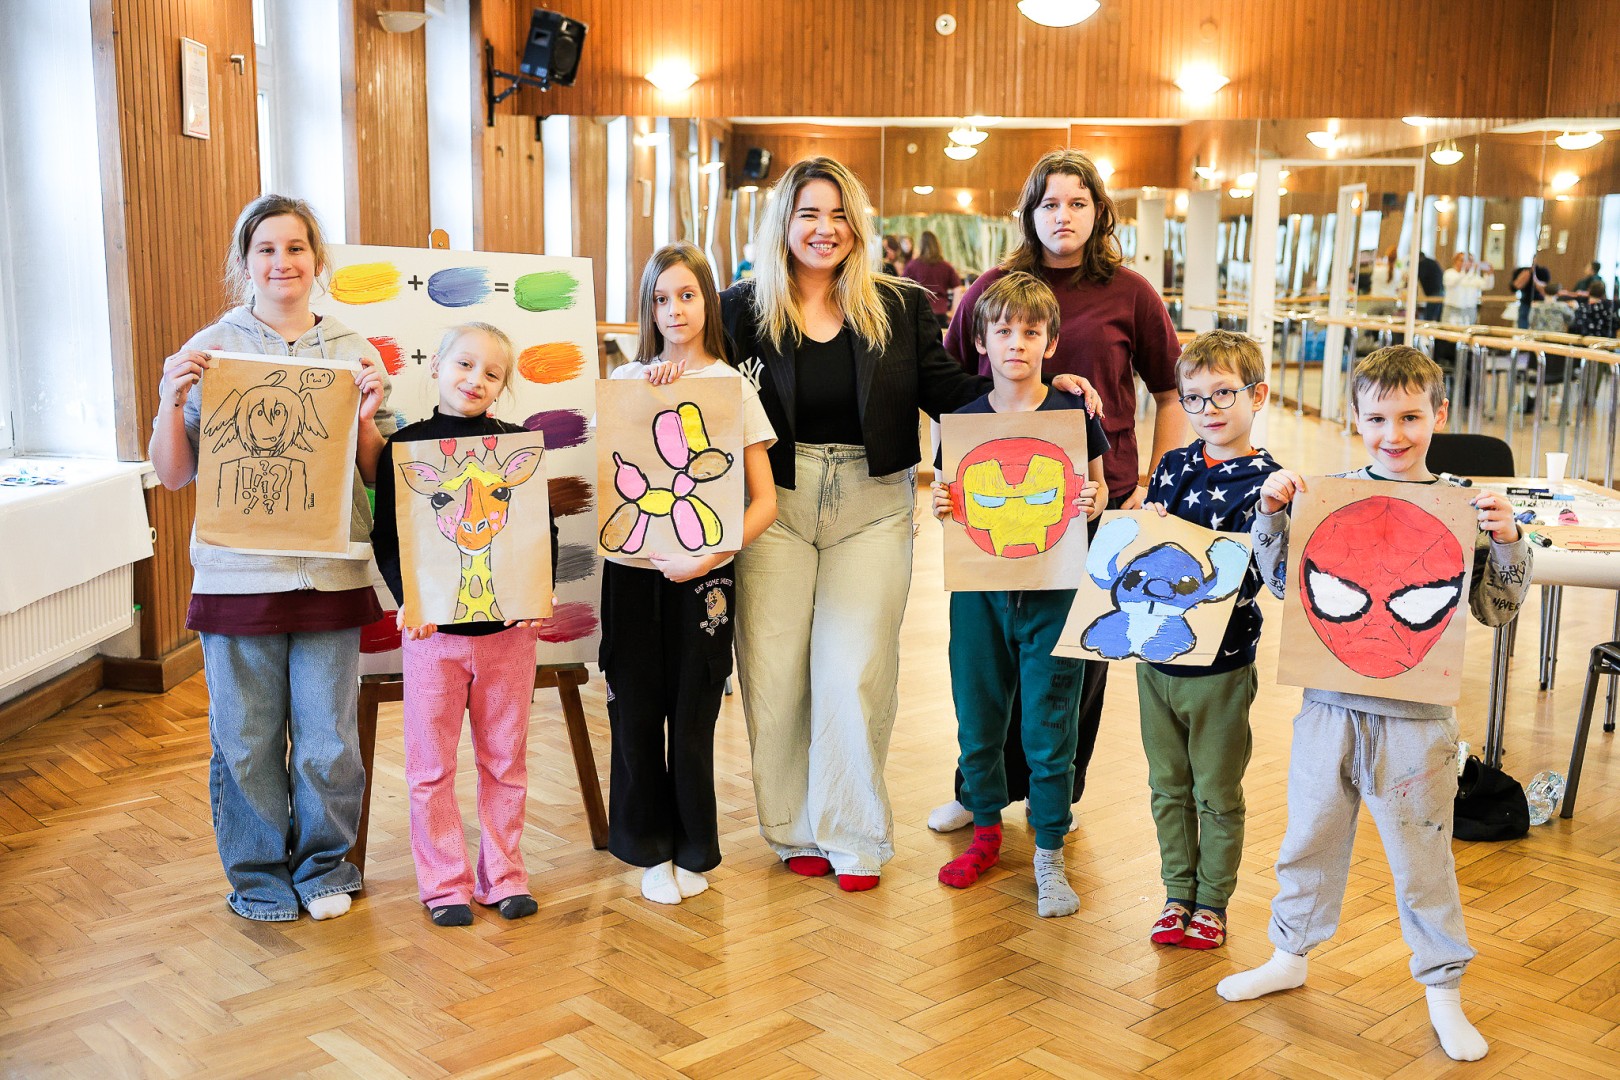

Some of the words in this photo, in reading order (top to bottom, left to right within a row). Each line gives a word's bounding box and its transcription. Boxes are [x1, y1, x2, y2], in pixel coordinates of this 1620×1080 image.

[695, 584, 705, 594] EAT
[705, 579, 719, 587] SOME
[1492, 597, 1521, 612] NEVER
